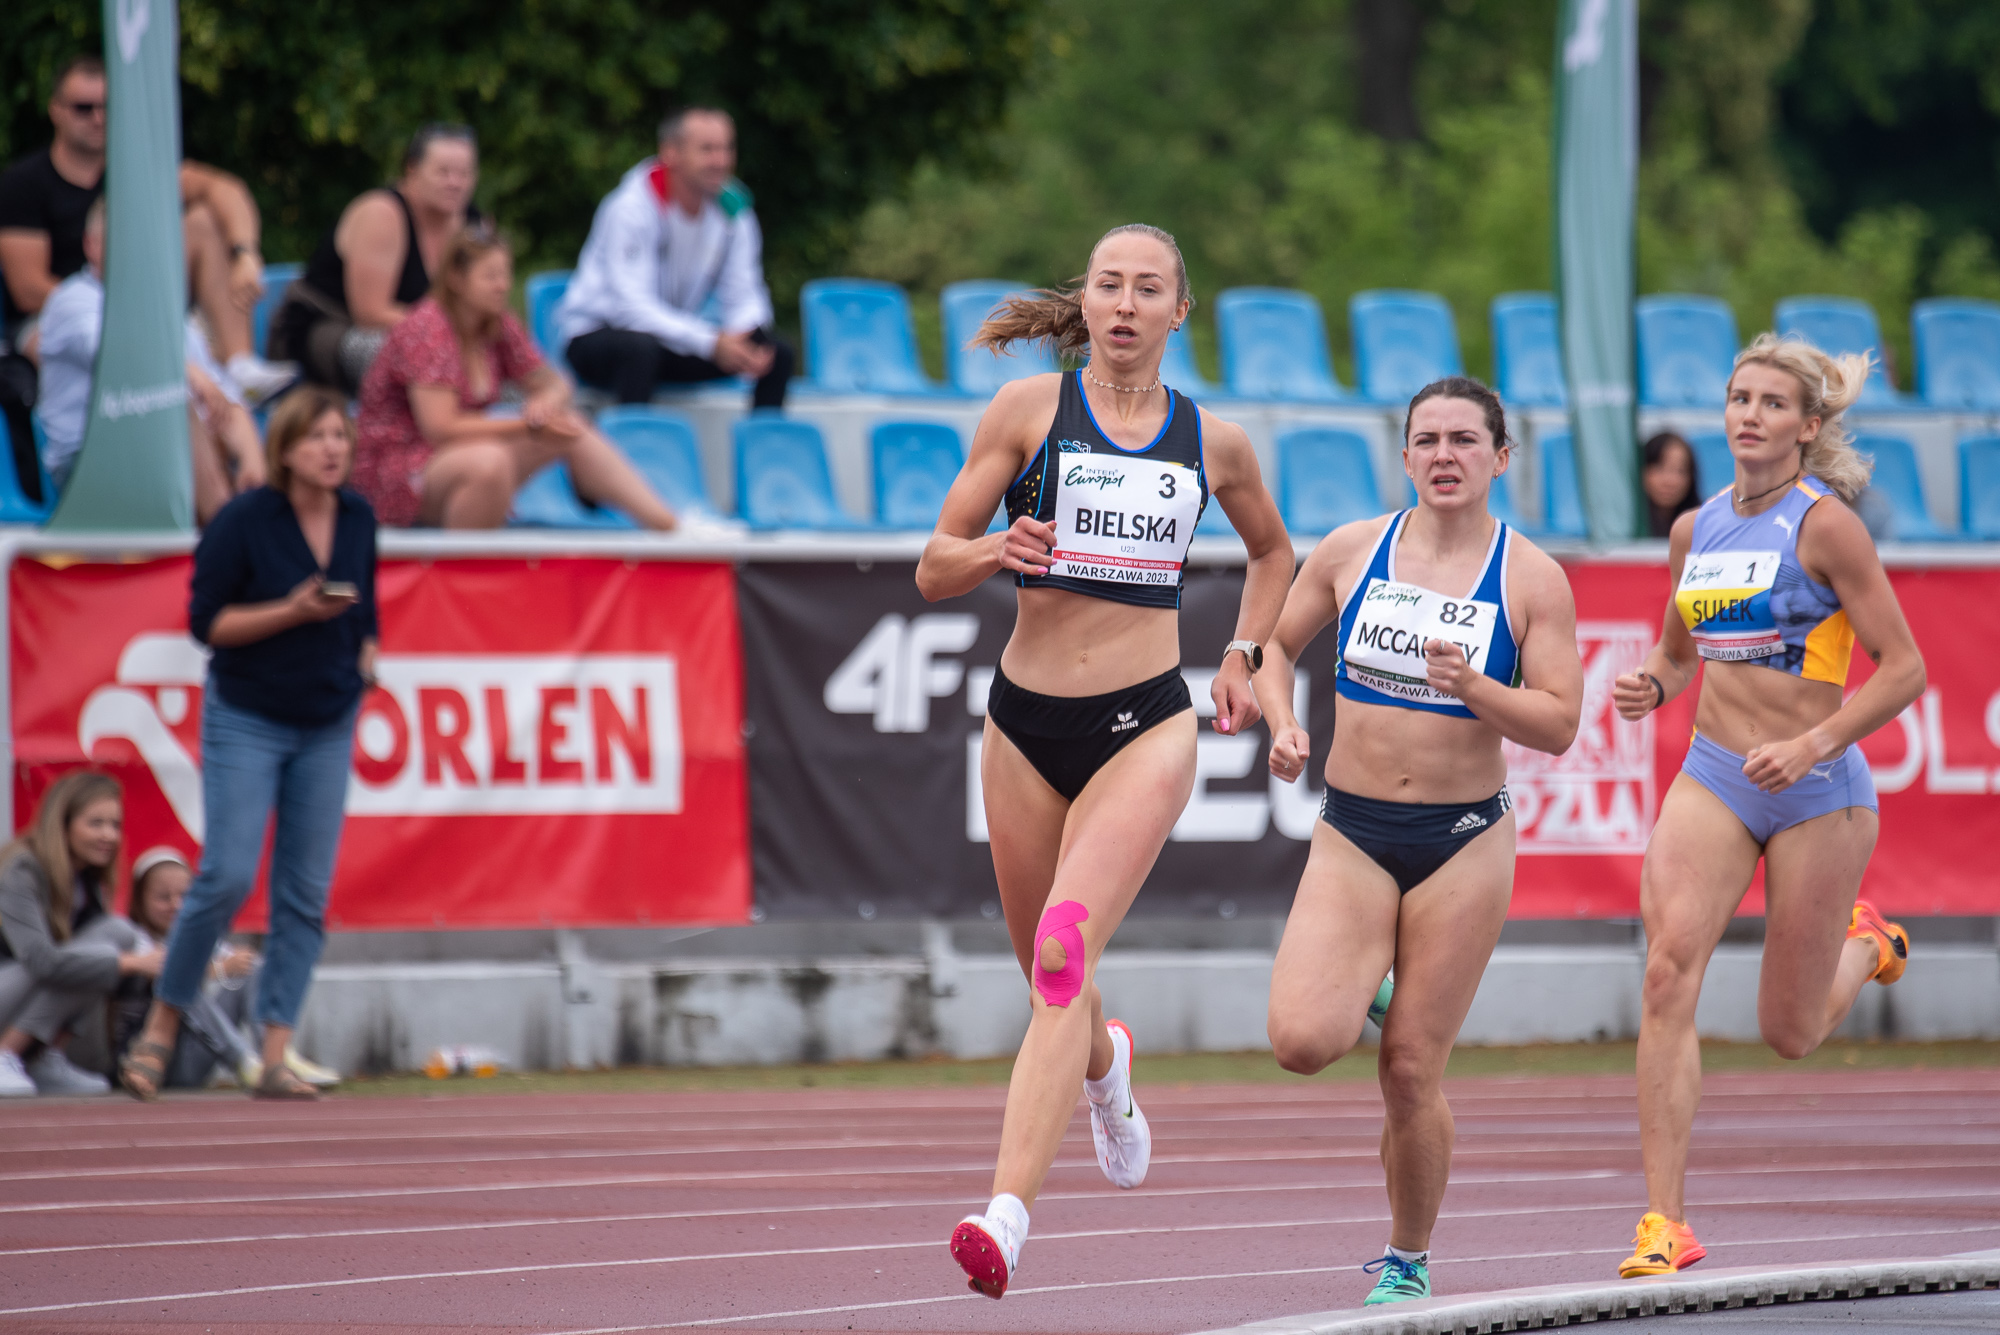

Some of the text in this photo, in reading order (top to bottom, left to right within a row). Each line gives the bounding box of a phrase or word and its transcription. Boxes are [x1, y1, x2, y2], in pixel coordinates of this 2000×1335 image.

[1065, 465, 1125, 490] Europol
[1158, 473, 1176, 499] 3
[1075, 507, 1177, 544] BIELSKA
[1061, 552, 1075, 560] PZLA
[1075, 554, 1114, 565] MISTRZOSTWA
[1114, 558, 1133, 567] POLSKI
[1120, 545, 1136, 554] U23
[1066, 563, 1168, 584] WARSZAWA 2023
[1744, 562, 1756, 584] 1
[1440, 602, 1478, 628] 82
[1693, 598, 1754, 623] SUŁEK
[1357, 621, 1480, 666] MCCAY
[1702, 646, 1773, 660] WARSZAWA 2023
[824, 612, 980, 733] 4F
[1357, 672, 1430, 698] WARSZAWA
[350, 683, 656, 790] ORLEN
[1451, 818, 1487, 834] adidas
